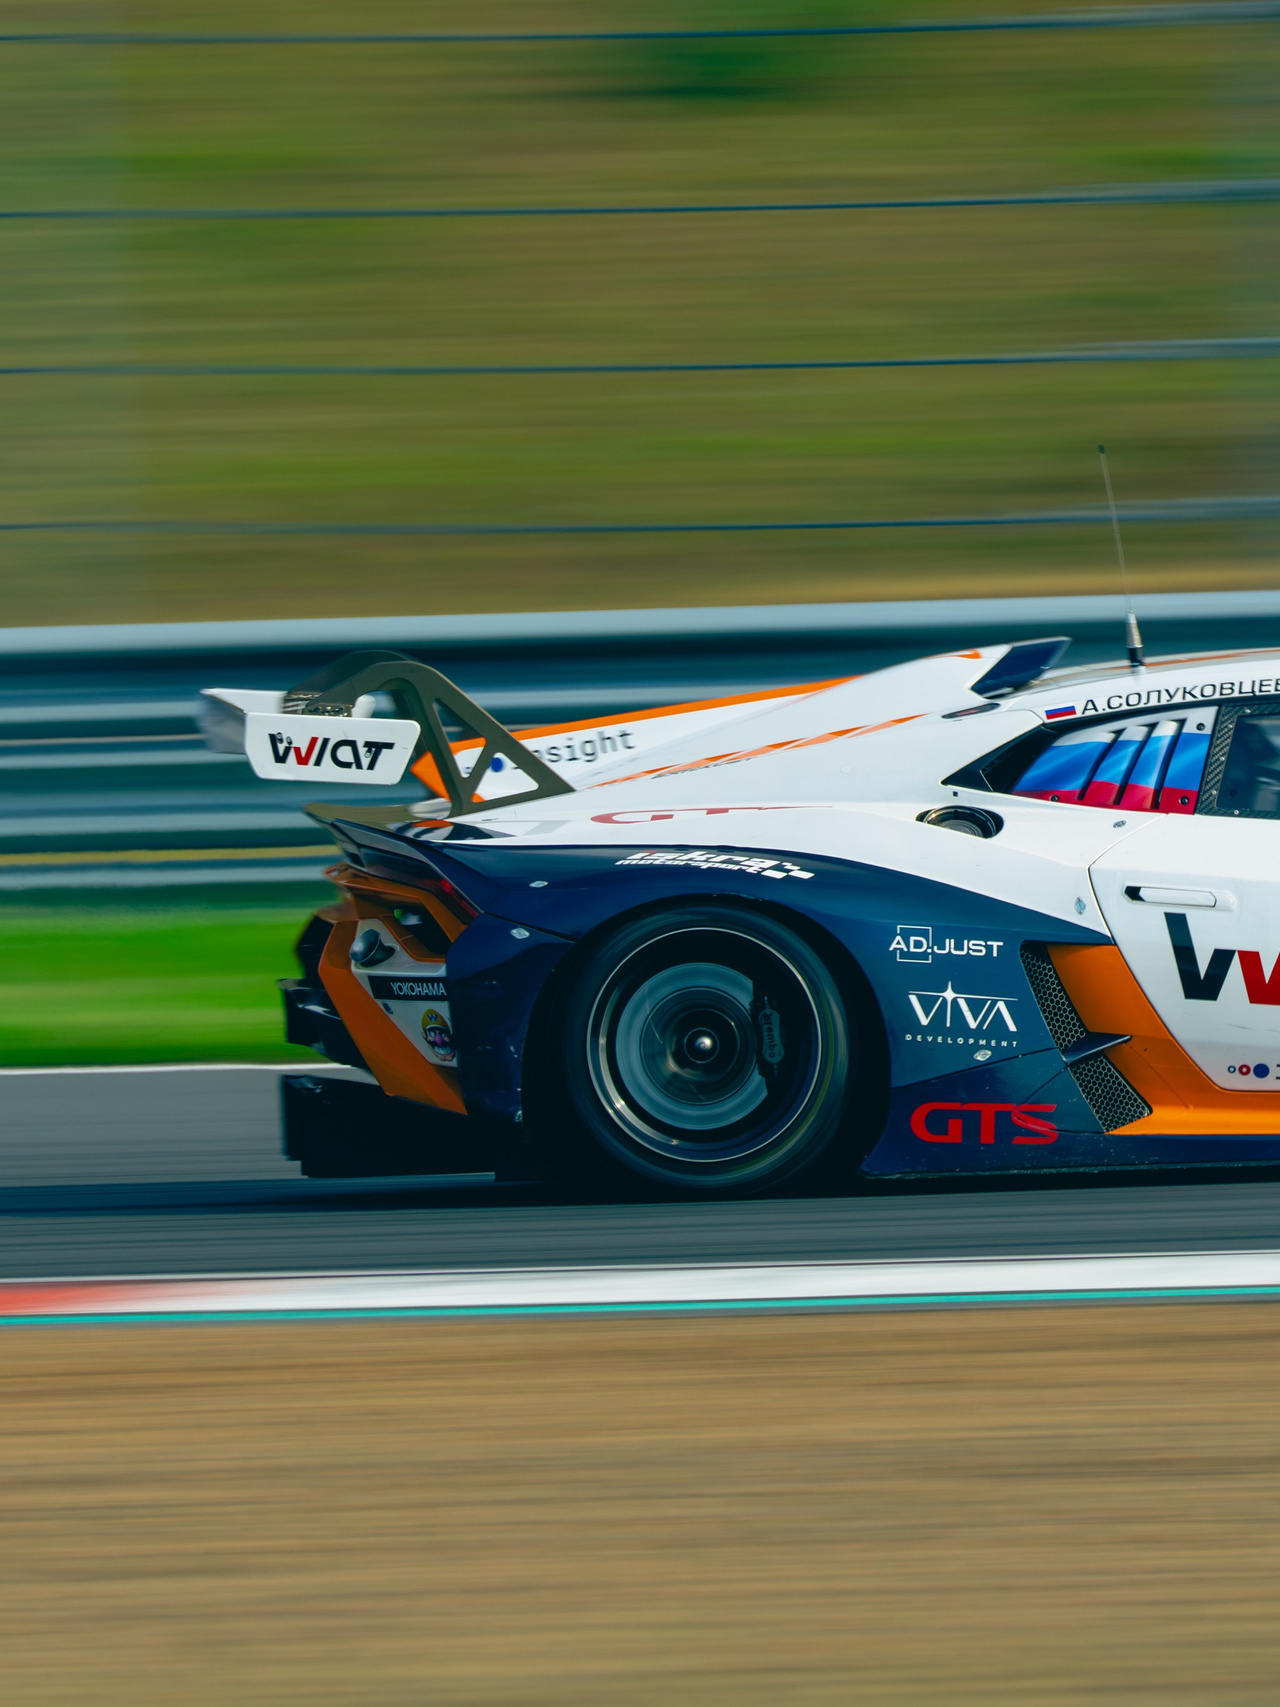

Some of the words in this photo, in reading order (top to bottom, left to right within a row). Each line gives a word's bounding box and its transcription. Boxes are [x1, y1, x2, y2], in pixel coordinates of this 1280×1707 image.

[268, 733, 395, 771] WIAT
[614, 859, 763, 874] motorsport
[390, 982, 447, 996] YOKOHAMA
[908, 983, 1018, 1032] VIVA
[763, 1013, 778, 1059] brembo
[905, 1034, 1018, 1047] DEVELOPMENT
[910, 1102, 1059, 1145] GTS
